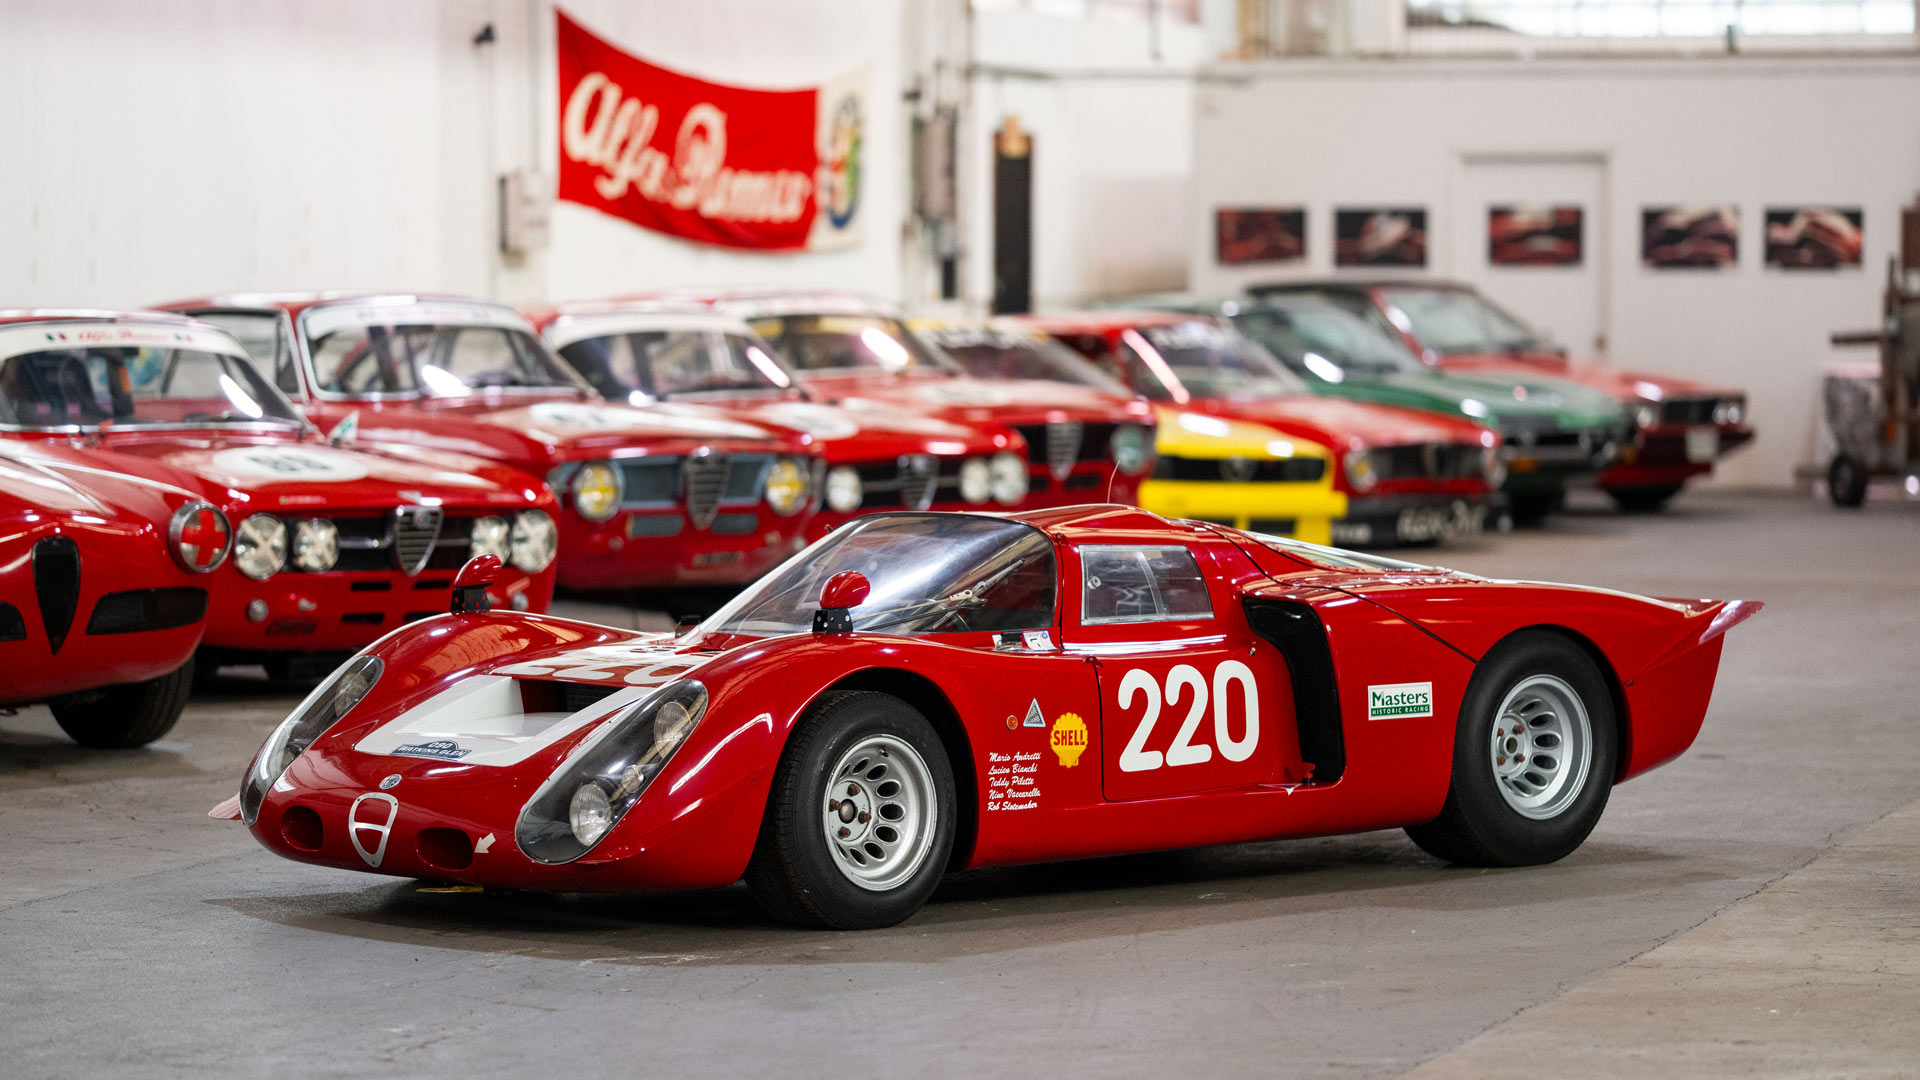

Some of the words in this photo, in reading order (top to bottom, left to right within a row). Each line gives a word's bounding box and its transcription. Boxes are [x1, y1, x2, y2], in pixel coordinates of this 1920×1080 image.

[563, 72, 670, 201] Alfa
[1372, 691, 1428, 706] Masters
[1118, 660, 1260, 772] 220
[1372, 707, 1402, 715] HISTORIC
[1404, 705, 1429, 713] RACING
[1053, 730, 1086, 746] SHELL
[989, 752, 1011, 762] Mario
[1013, 751, 1041, 761] Andretti
[988, 765, 1010, 775] Lucien
[1012, 763, 1038, 774] Bianchi
[989, 777, 1010, 788] Teddy
[1011, 776, 1034, 787] Pilette
[989, 789, 1004, 800] Nino
[1006, 787, 1041, 798] Vaccarella
[987, 801, 1001, 811] Rob
[1002, 800, 1037, 811] Slotemaker
